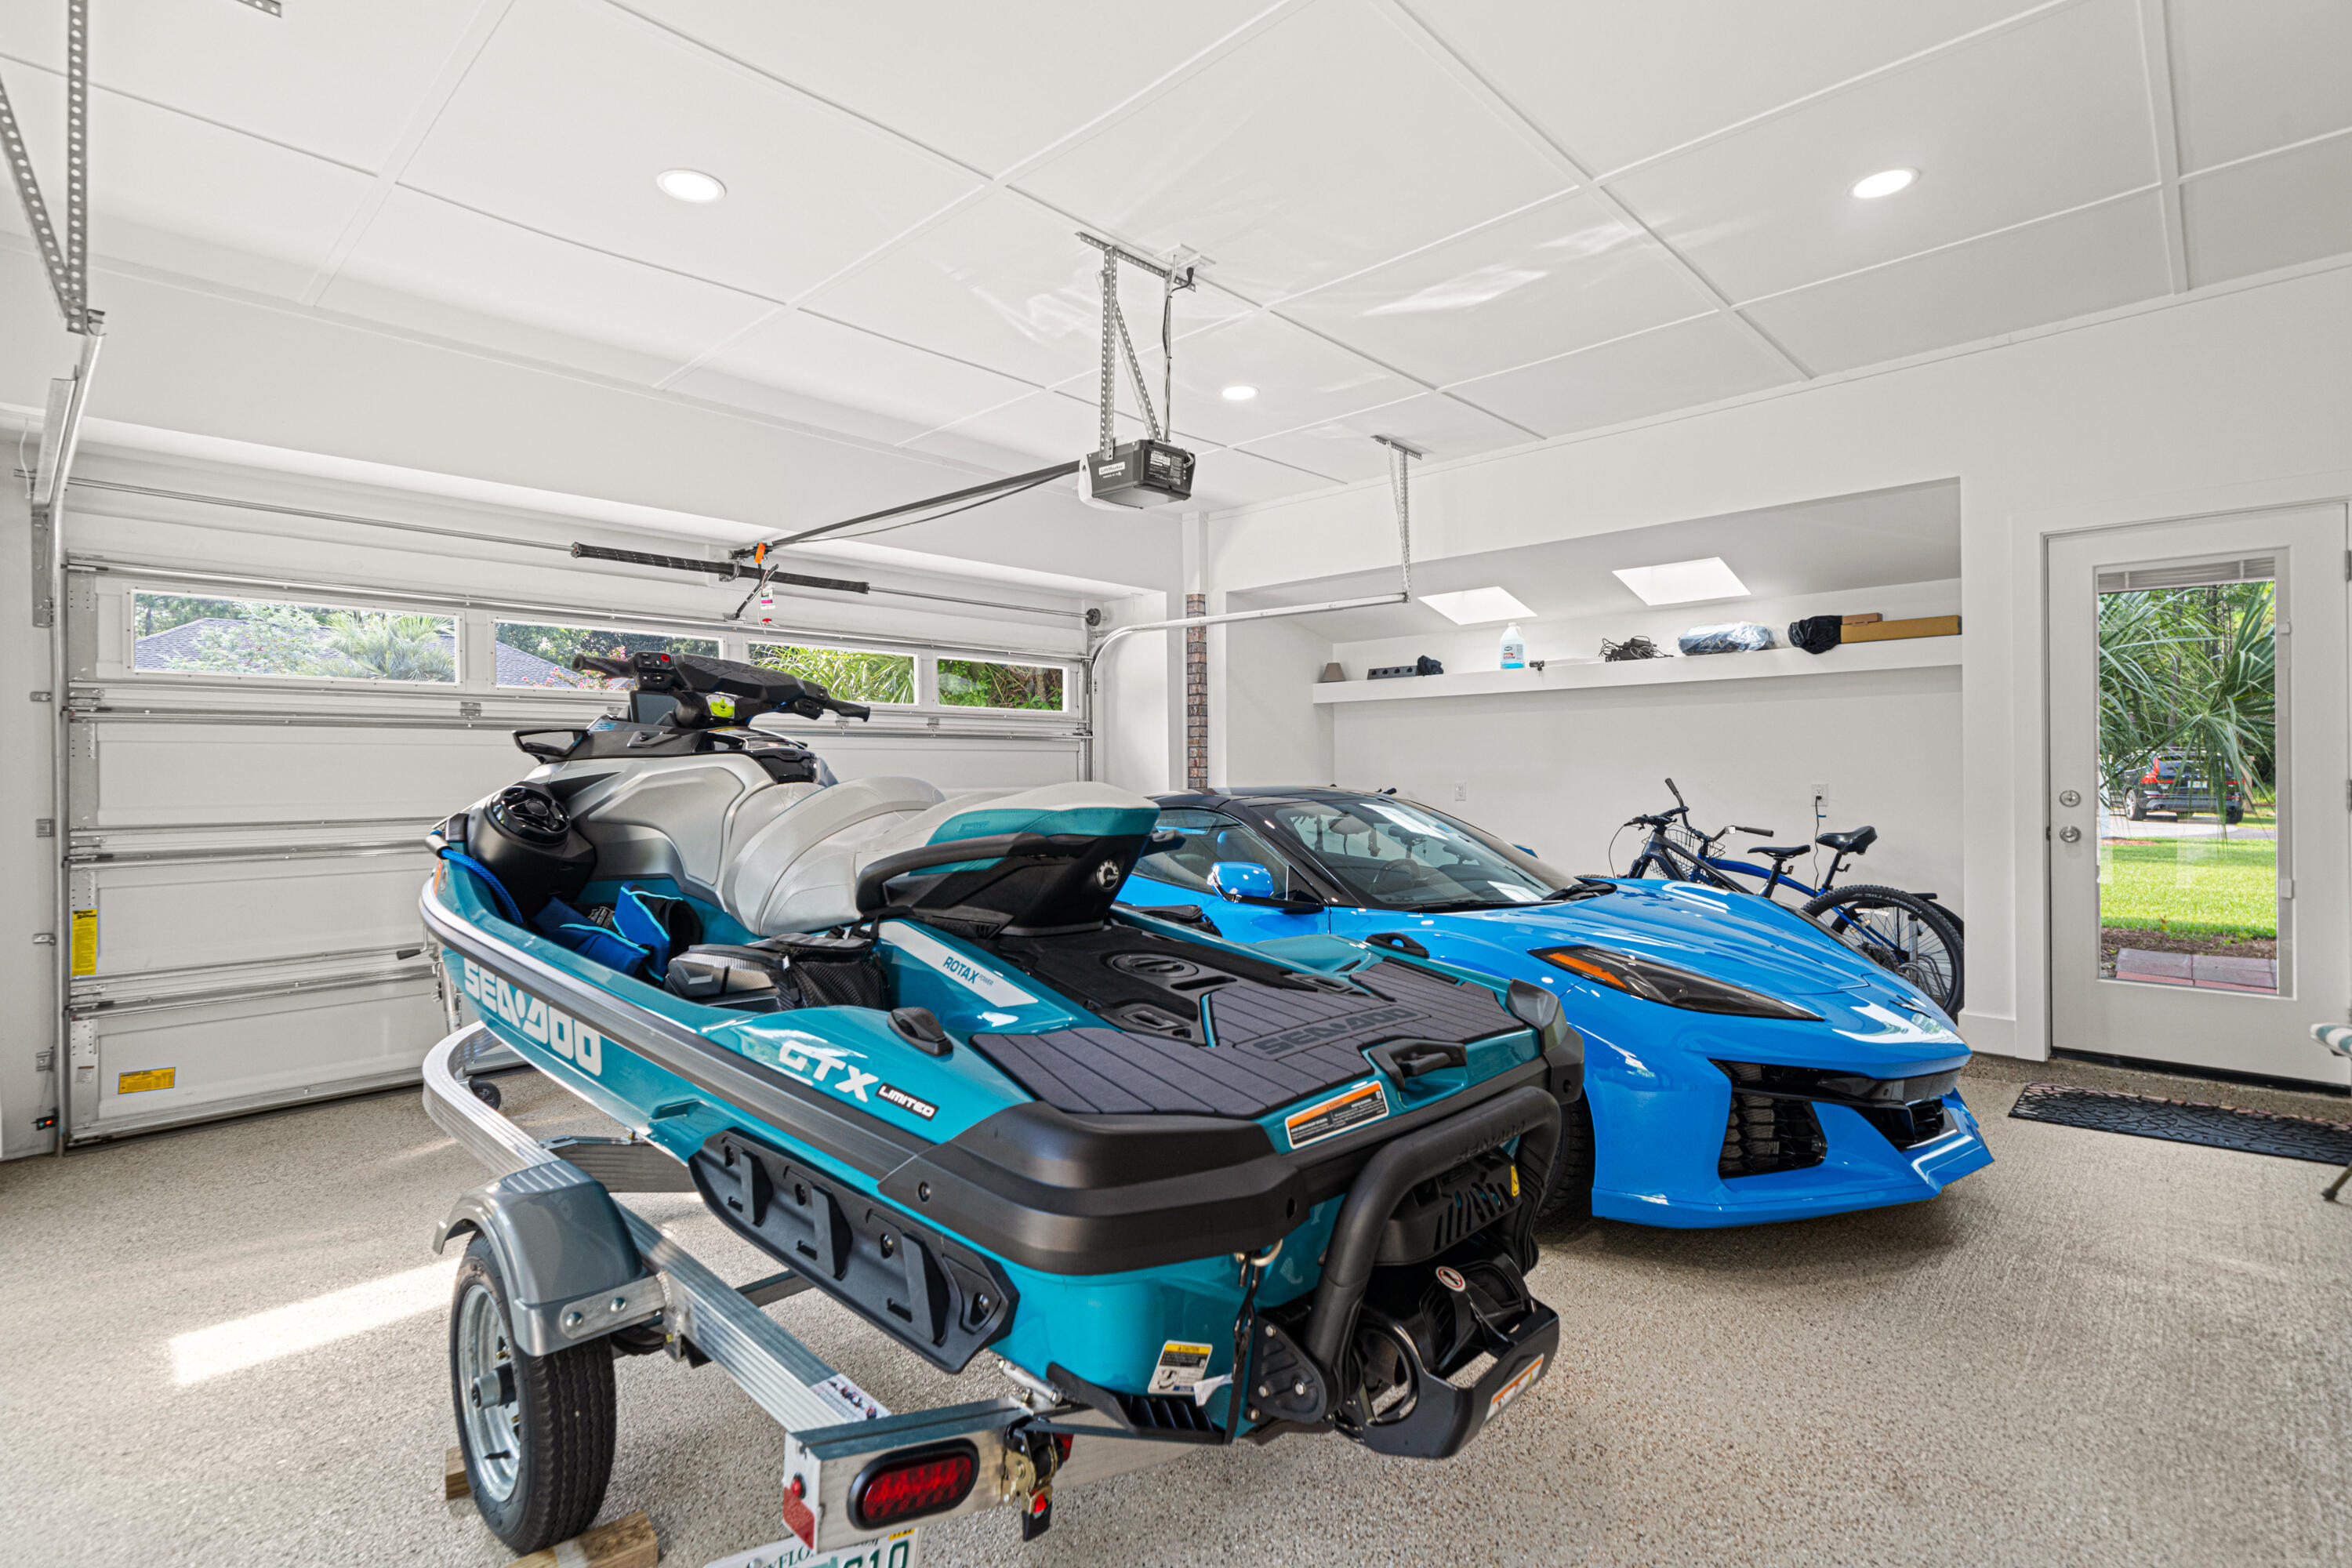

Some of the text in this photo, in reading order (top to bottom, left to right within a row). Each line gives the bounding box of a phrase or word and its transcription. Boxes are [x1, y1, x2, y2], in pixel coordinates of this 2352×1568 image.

[942, 956, 980, 985] ROTAX
[779, 1040, 936, 1118] GTX LIMITED
